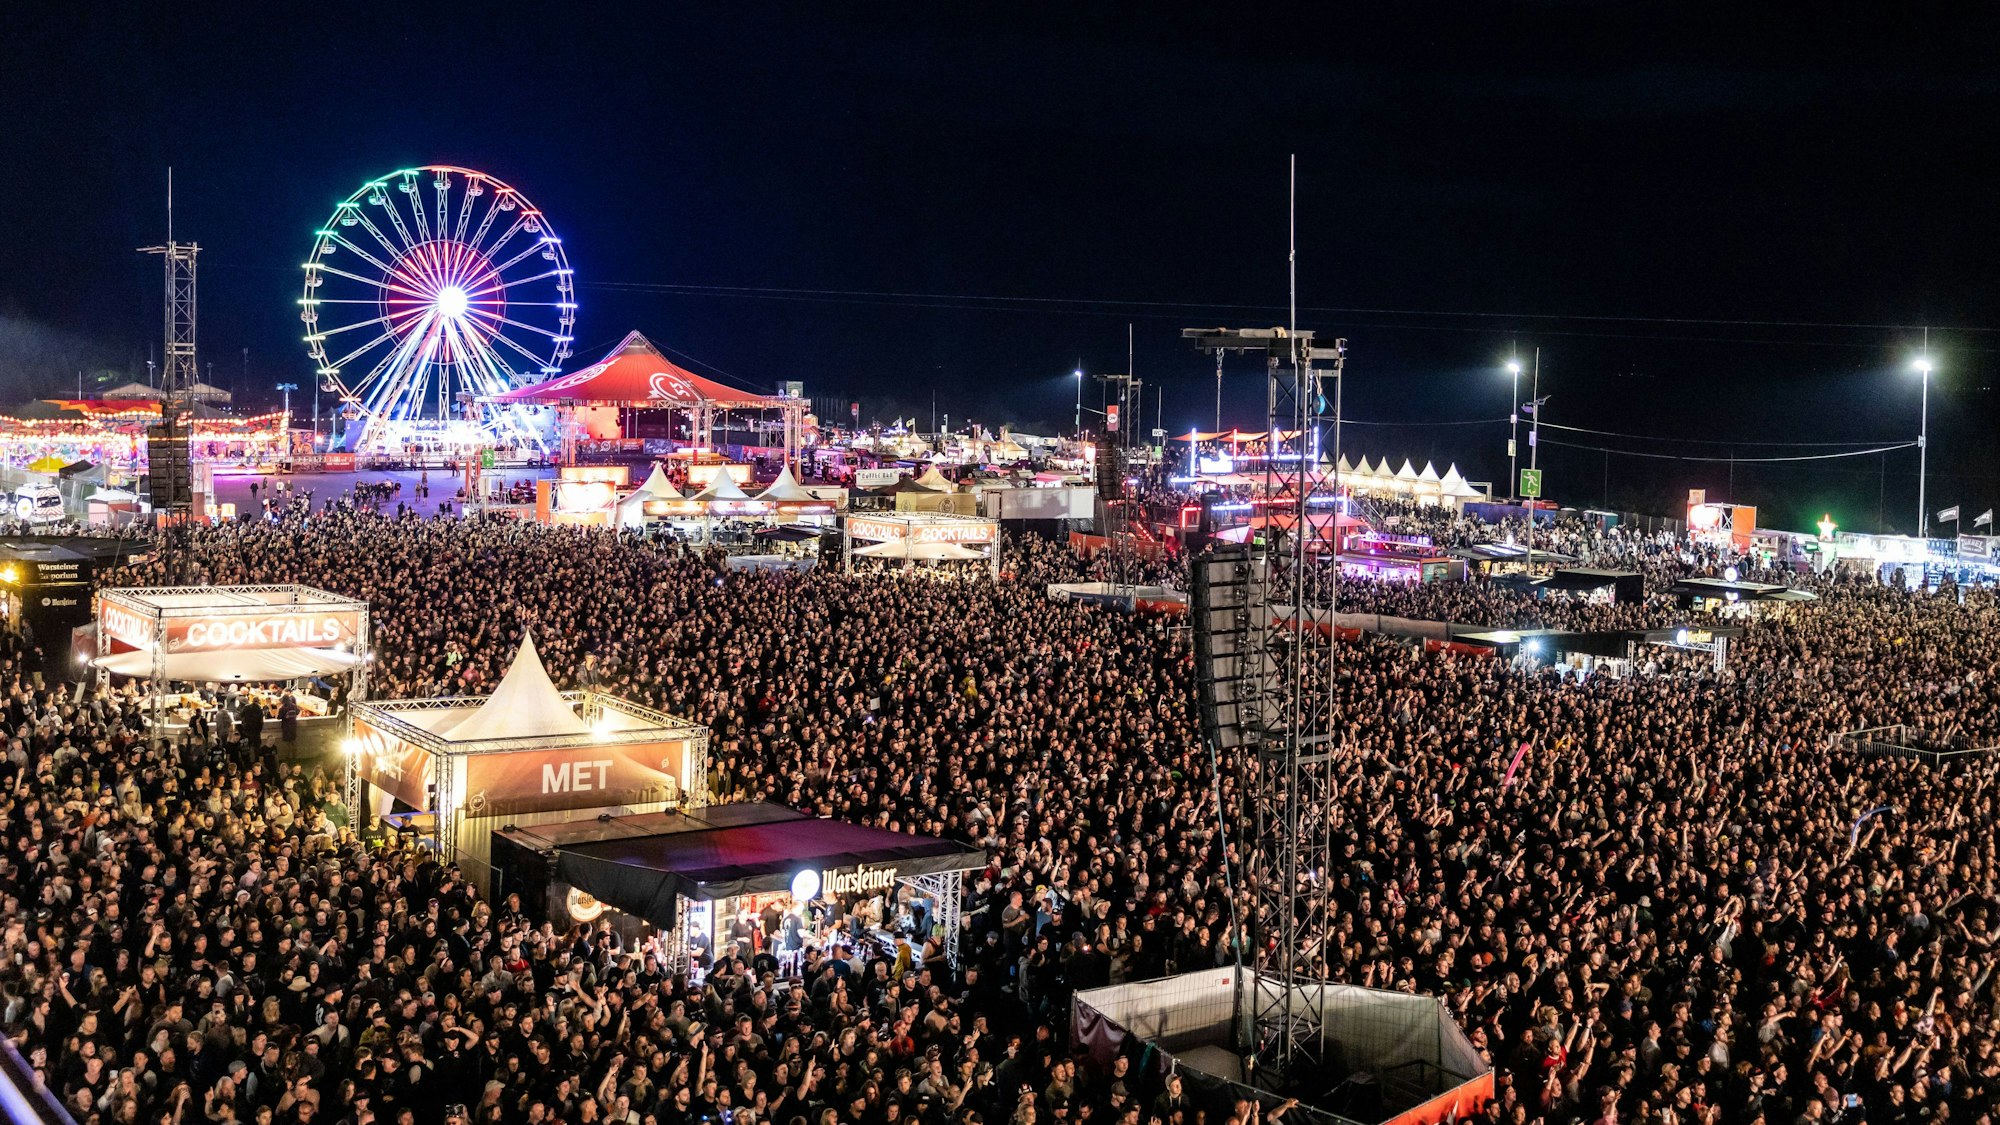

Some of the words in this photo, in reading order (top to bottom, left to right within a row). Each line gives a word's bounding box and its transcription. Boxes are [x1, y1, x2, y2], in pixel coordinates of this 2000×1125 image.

[853, 521, 900, 539] COCKTAILS
[921, 527, 988, 540] COCKTAILS
[37, 563, 79, 572] Warsteiner
[105, 607, 149, 645] COCKTAILS
[187, 618, 340, 647] COCKTAILS
[542, 760, 613, 794] MET
[822, 864, 897, 894] Warsteiner
